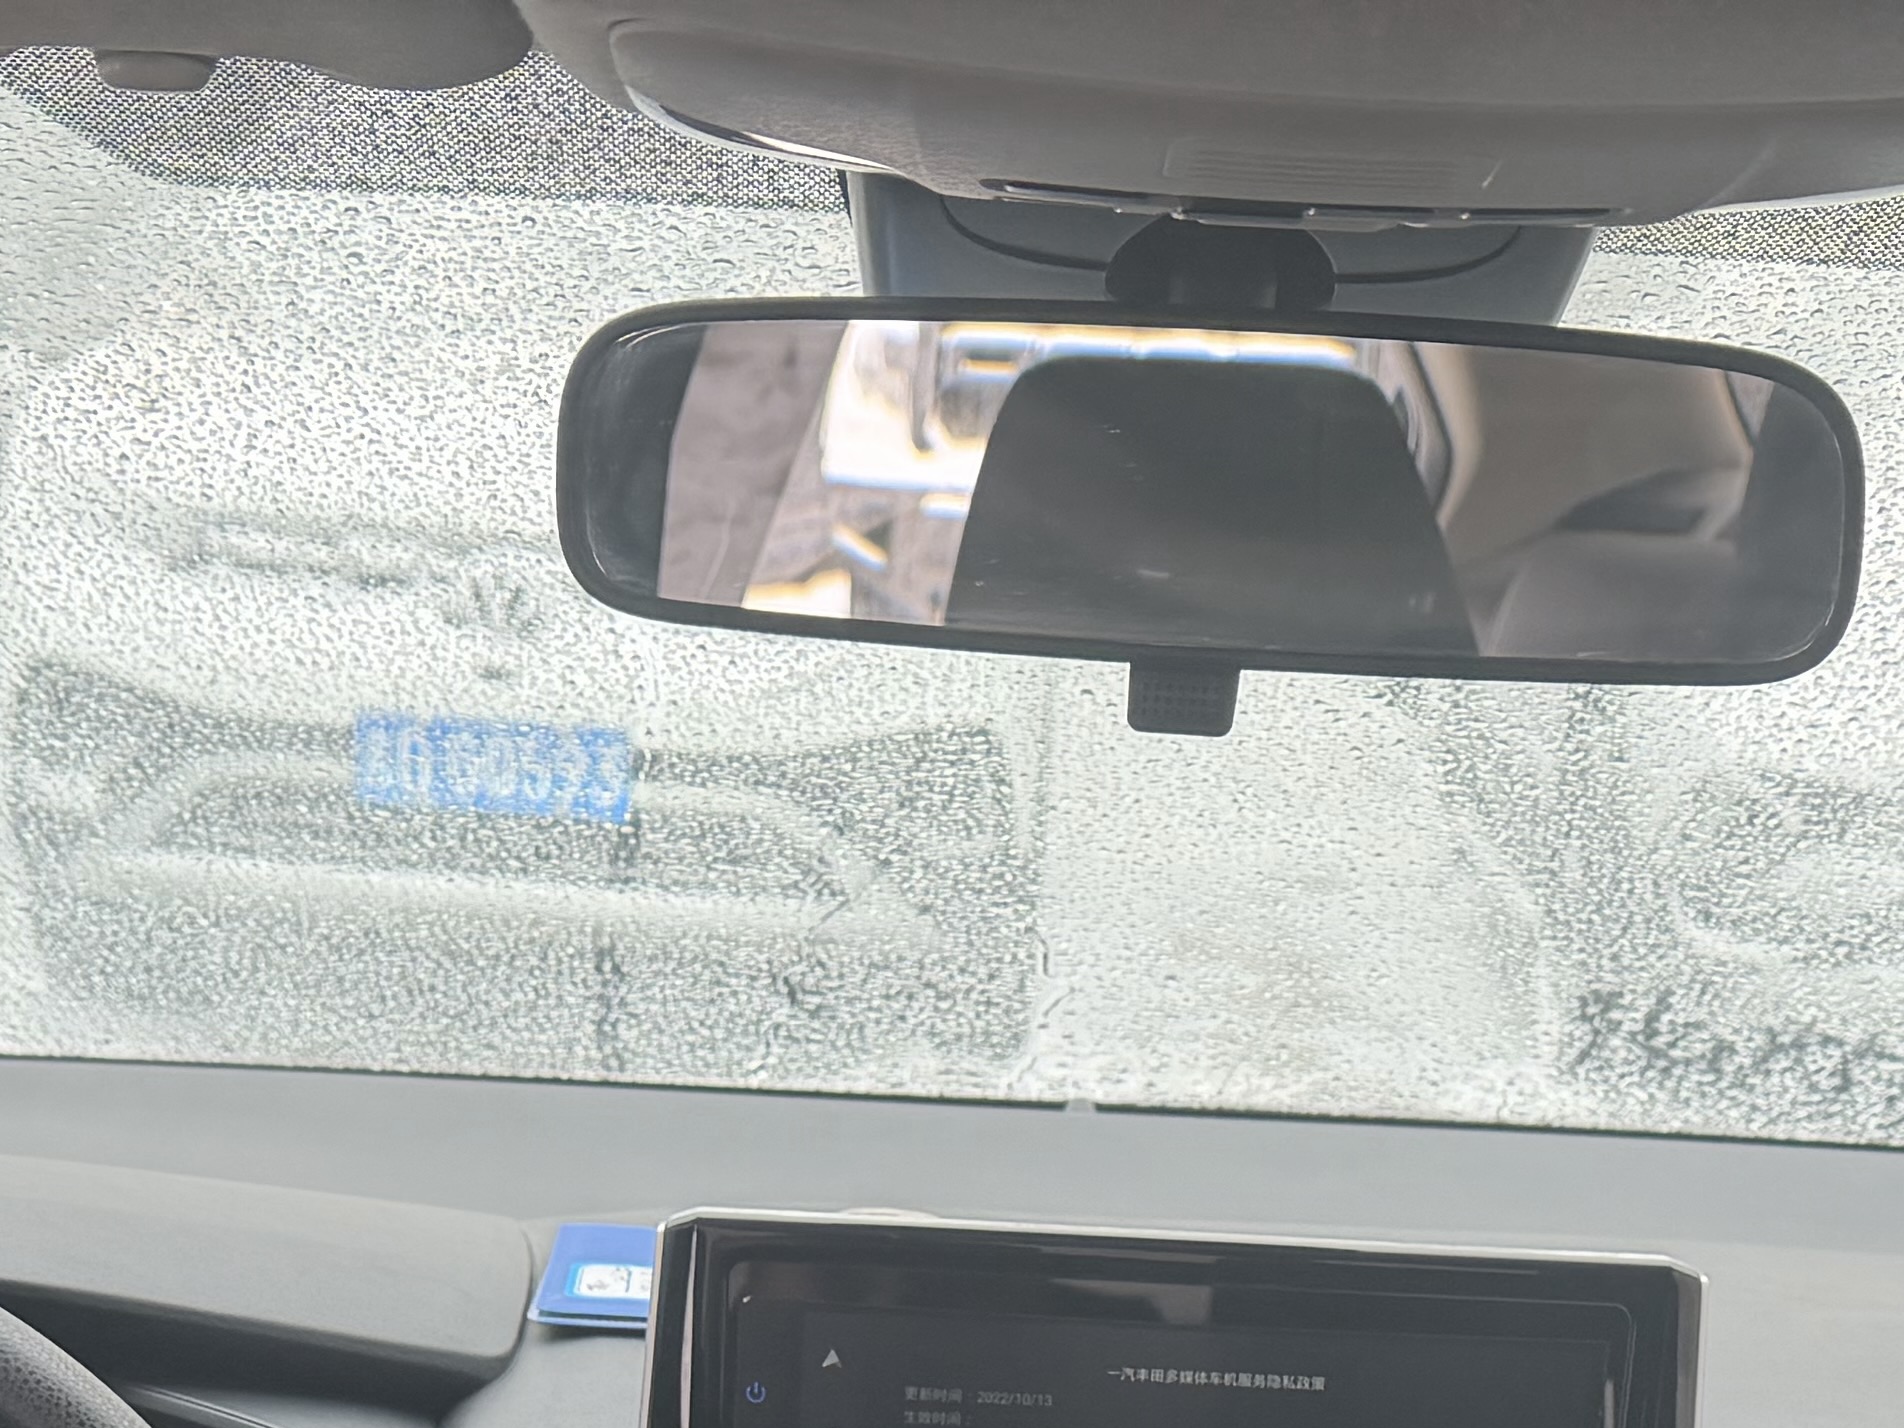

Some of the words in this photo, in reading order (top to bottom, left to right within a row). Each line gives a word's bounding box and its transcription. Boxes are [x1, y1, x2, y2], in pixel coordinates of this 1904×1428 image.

[1107, 1366, 1326, 1391] 一汽丰田多媒体车机服务隐私政策
